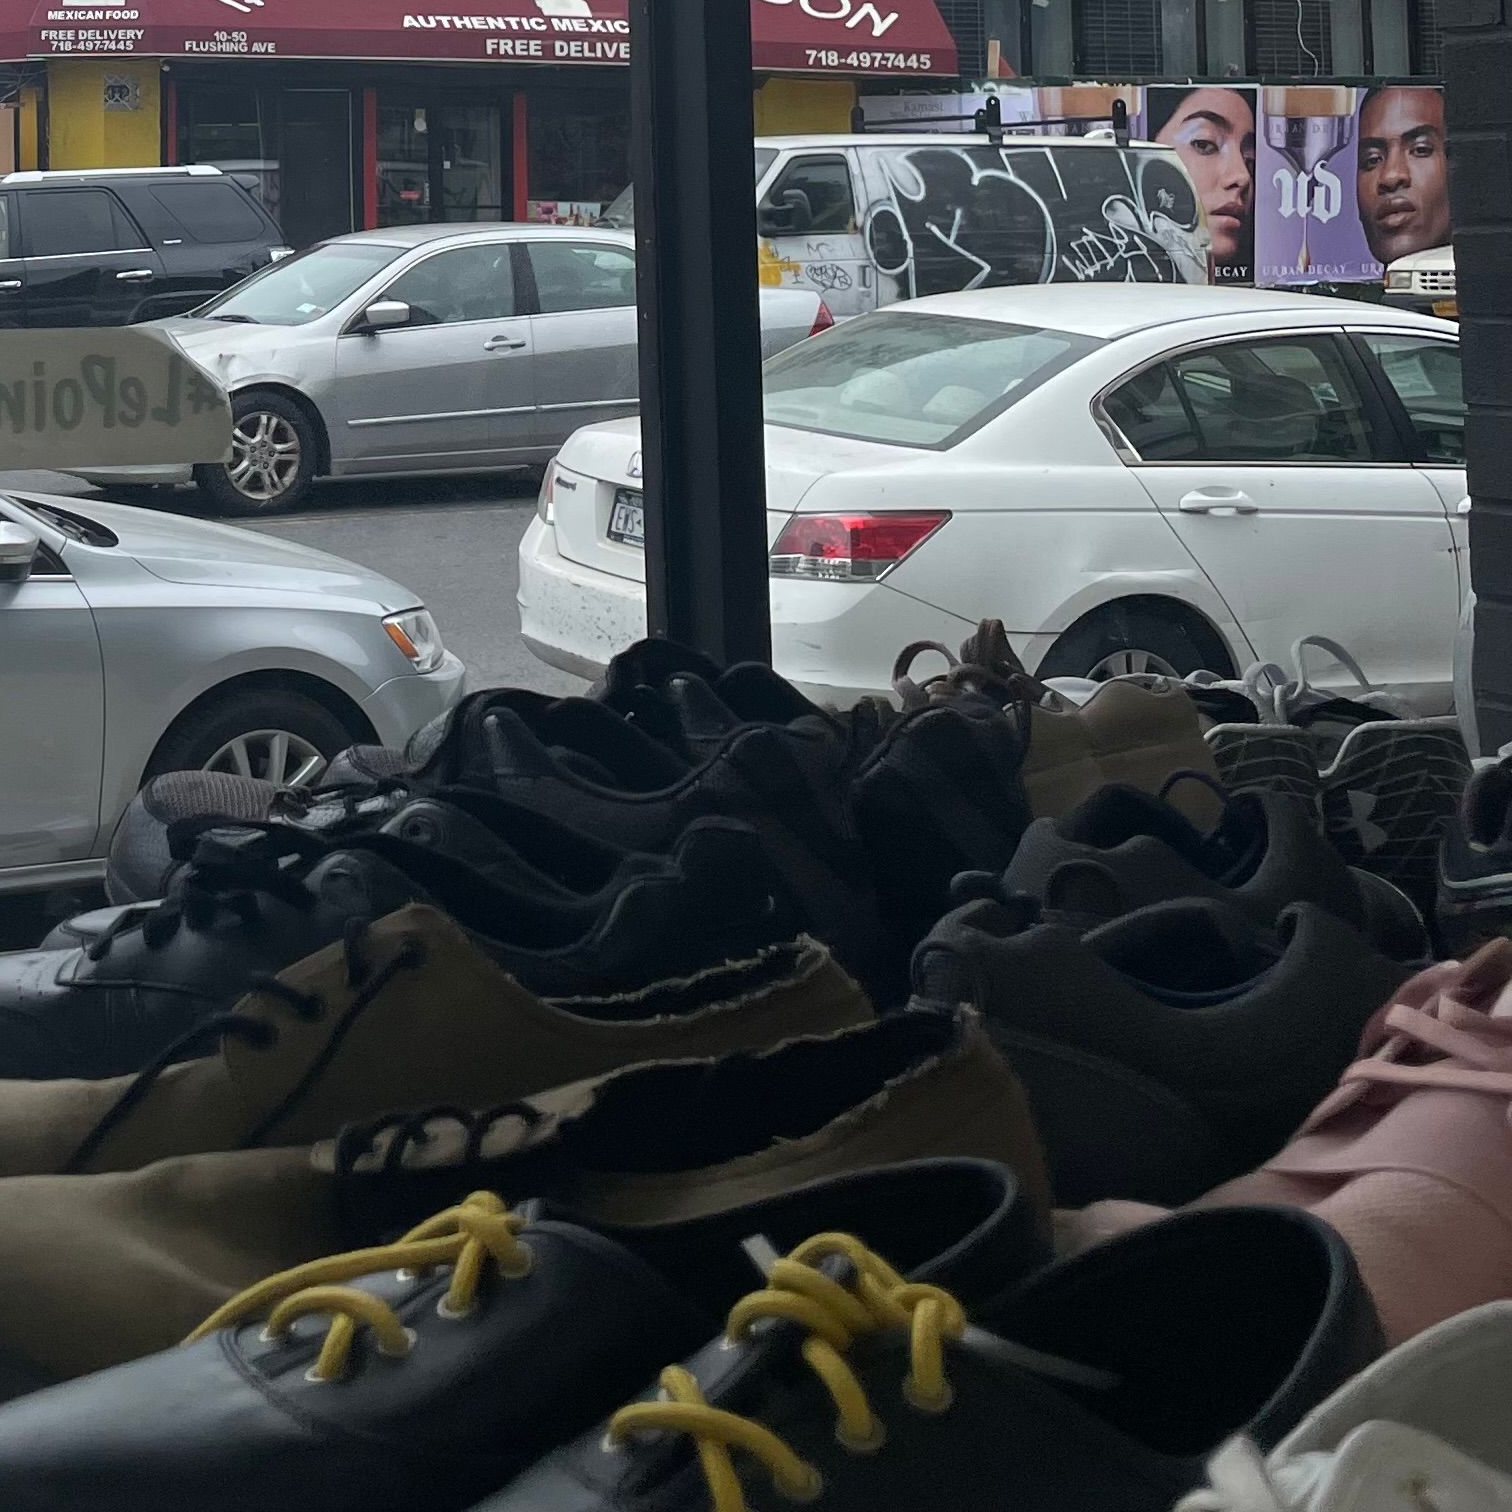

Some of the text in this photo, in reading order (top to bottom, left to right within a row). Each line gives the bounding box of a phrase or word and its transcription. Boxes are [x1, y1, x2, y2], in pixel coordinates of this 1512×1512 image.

[47, 9, 139, 21] MEXICAN FOOD
[402, 14, 630, 34] AUTHENTIC MEXIC
[40, 29, 144, 40] FREE DELIVERY
[214, 31, 247, 42] 10-50
[50, 40, 134, 51] 718-497-7445
[185, 41, 276, 53] FLUSHING AVE
[485, 38, 630, 59] FREE DELIVE
[805, 49, 932, 71] 718-497-7445
[1214, 265, 1248, 278] ECAY
[1308, 263, 1346, 275] DECAY
